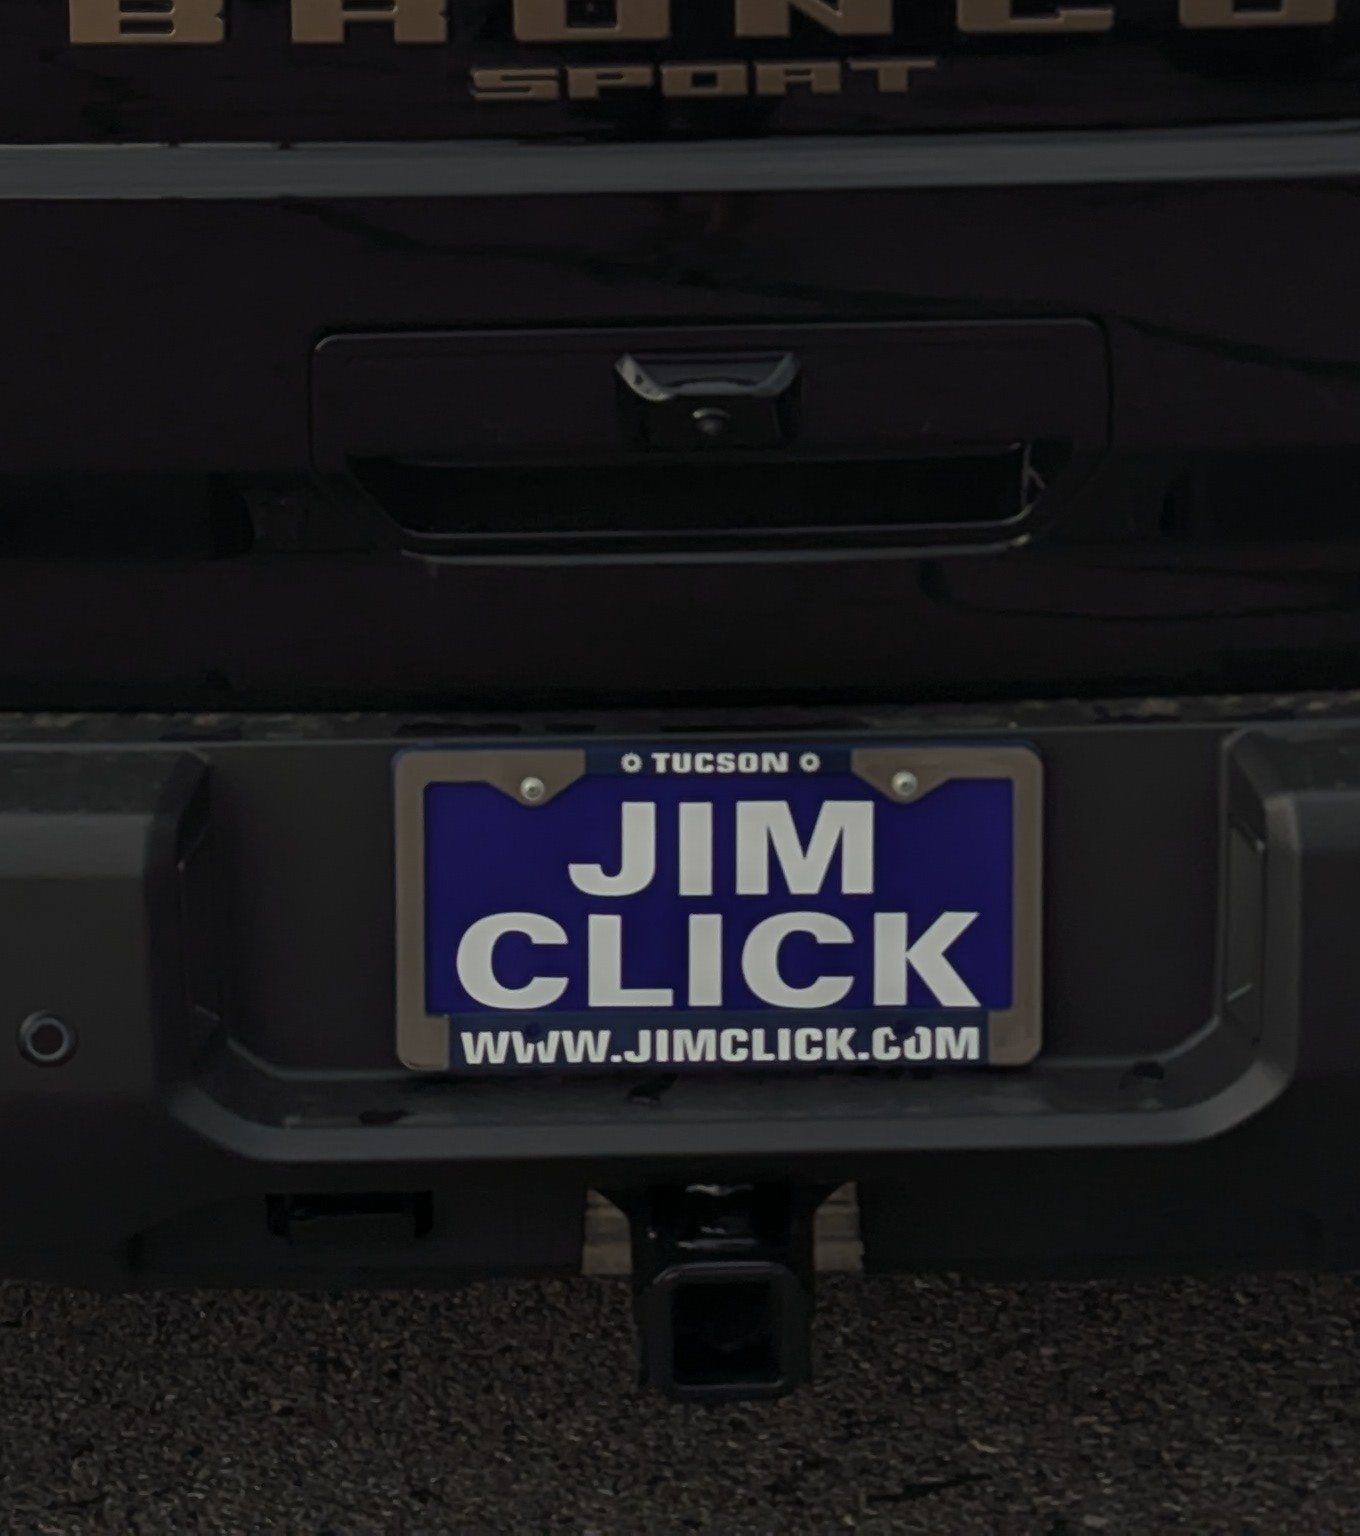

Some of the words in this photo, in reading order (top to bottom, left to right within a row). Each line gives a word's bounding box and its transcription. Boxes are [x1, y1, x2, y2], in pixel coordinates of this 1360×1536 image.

[470, 58, 938, 102] SPORT
[651, 751, 789, 774] TUCSON
[567, 800, 875, 897] JIM
[455, 911, 981, 1010] CLICK
[460, 1026, 981, 1065] WWW.JIMCLICK.COM
